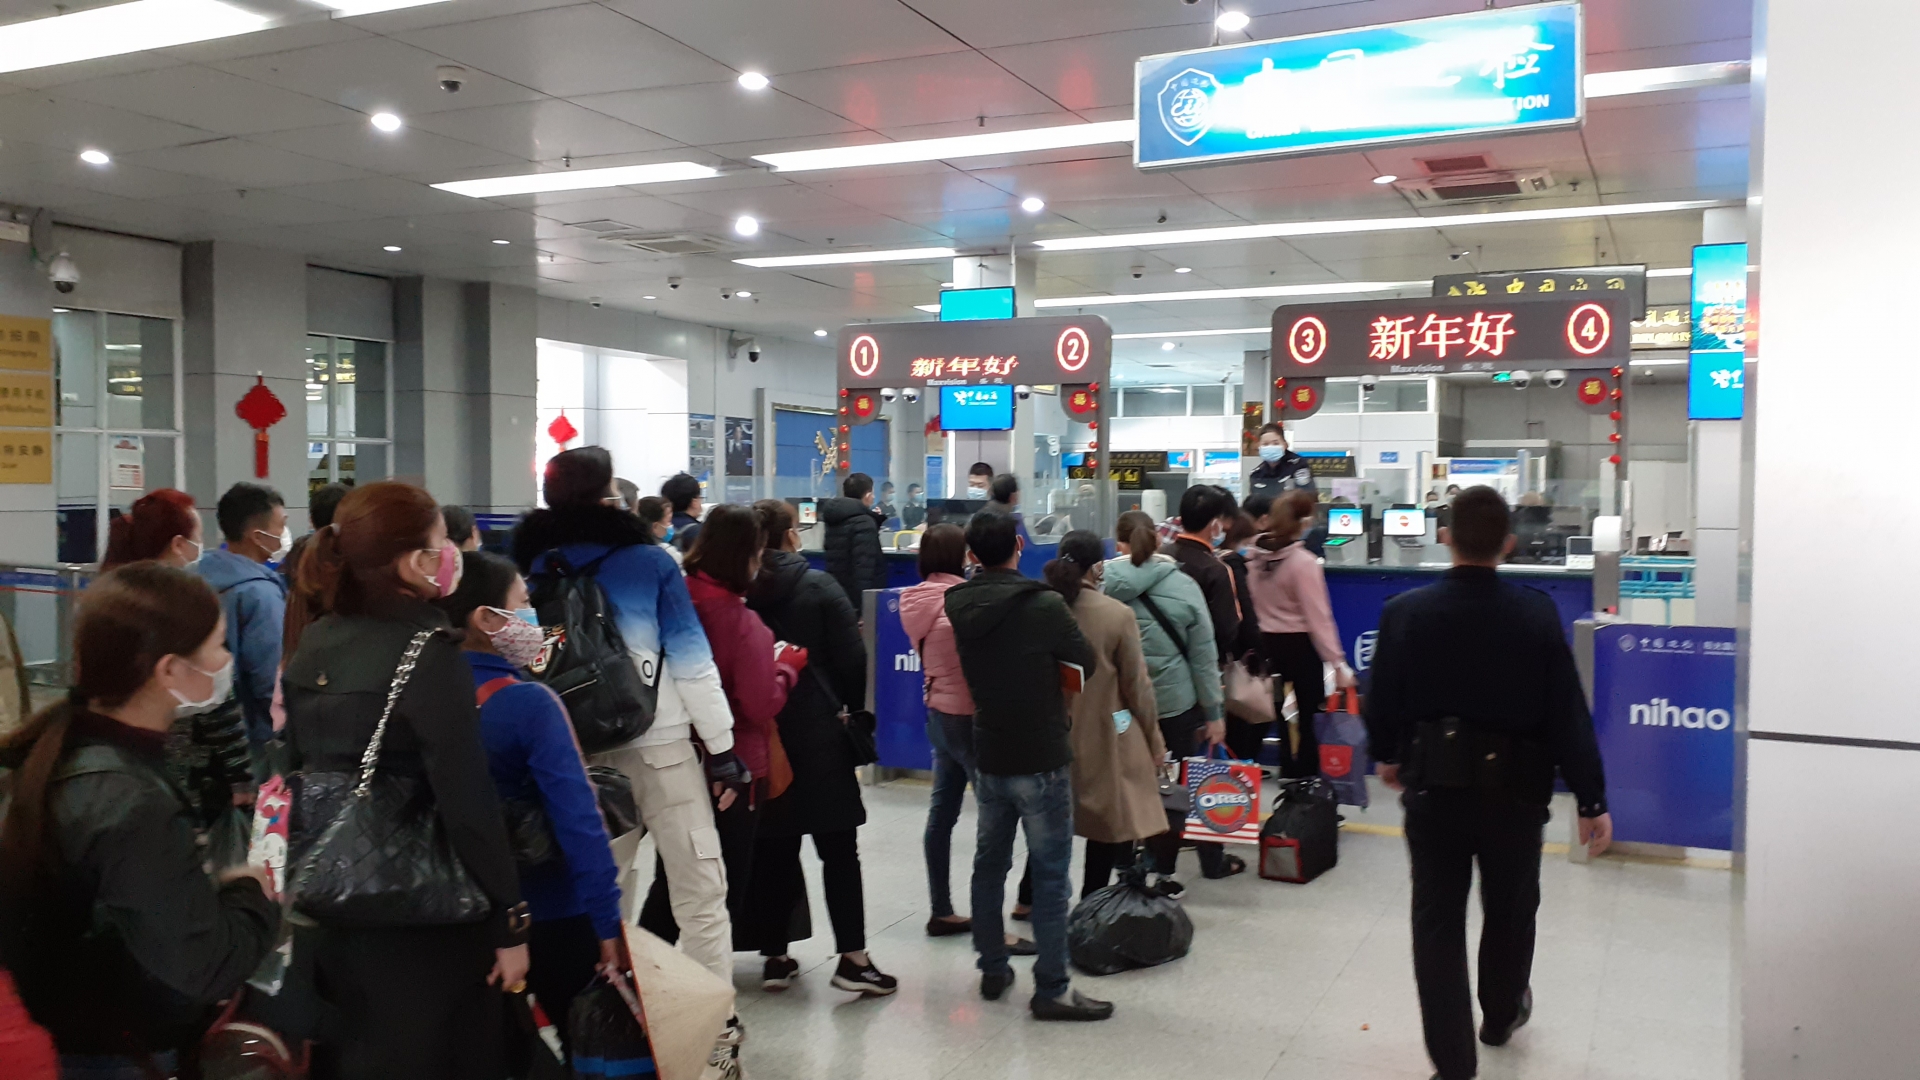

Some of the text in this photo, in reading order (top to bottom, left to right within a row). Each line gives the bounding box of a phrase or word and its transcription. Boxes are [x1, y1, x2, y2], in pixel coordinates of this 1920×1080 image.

[1301, 328, 1315, 352] 3
[1369, 311, 1516, 360] 新年好
[1581, 316, 1598, 342] 4
[1067, 338, 1080, 360] 2
[910, 355, 1020, 377] 新年好
[1629, 697, 1730, 731] nihao
[1199, 793, 1249, 809] OREO
